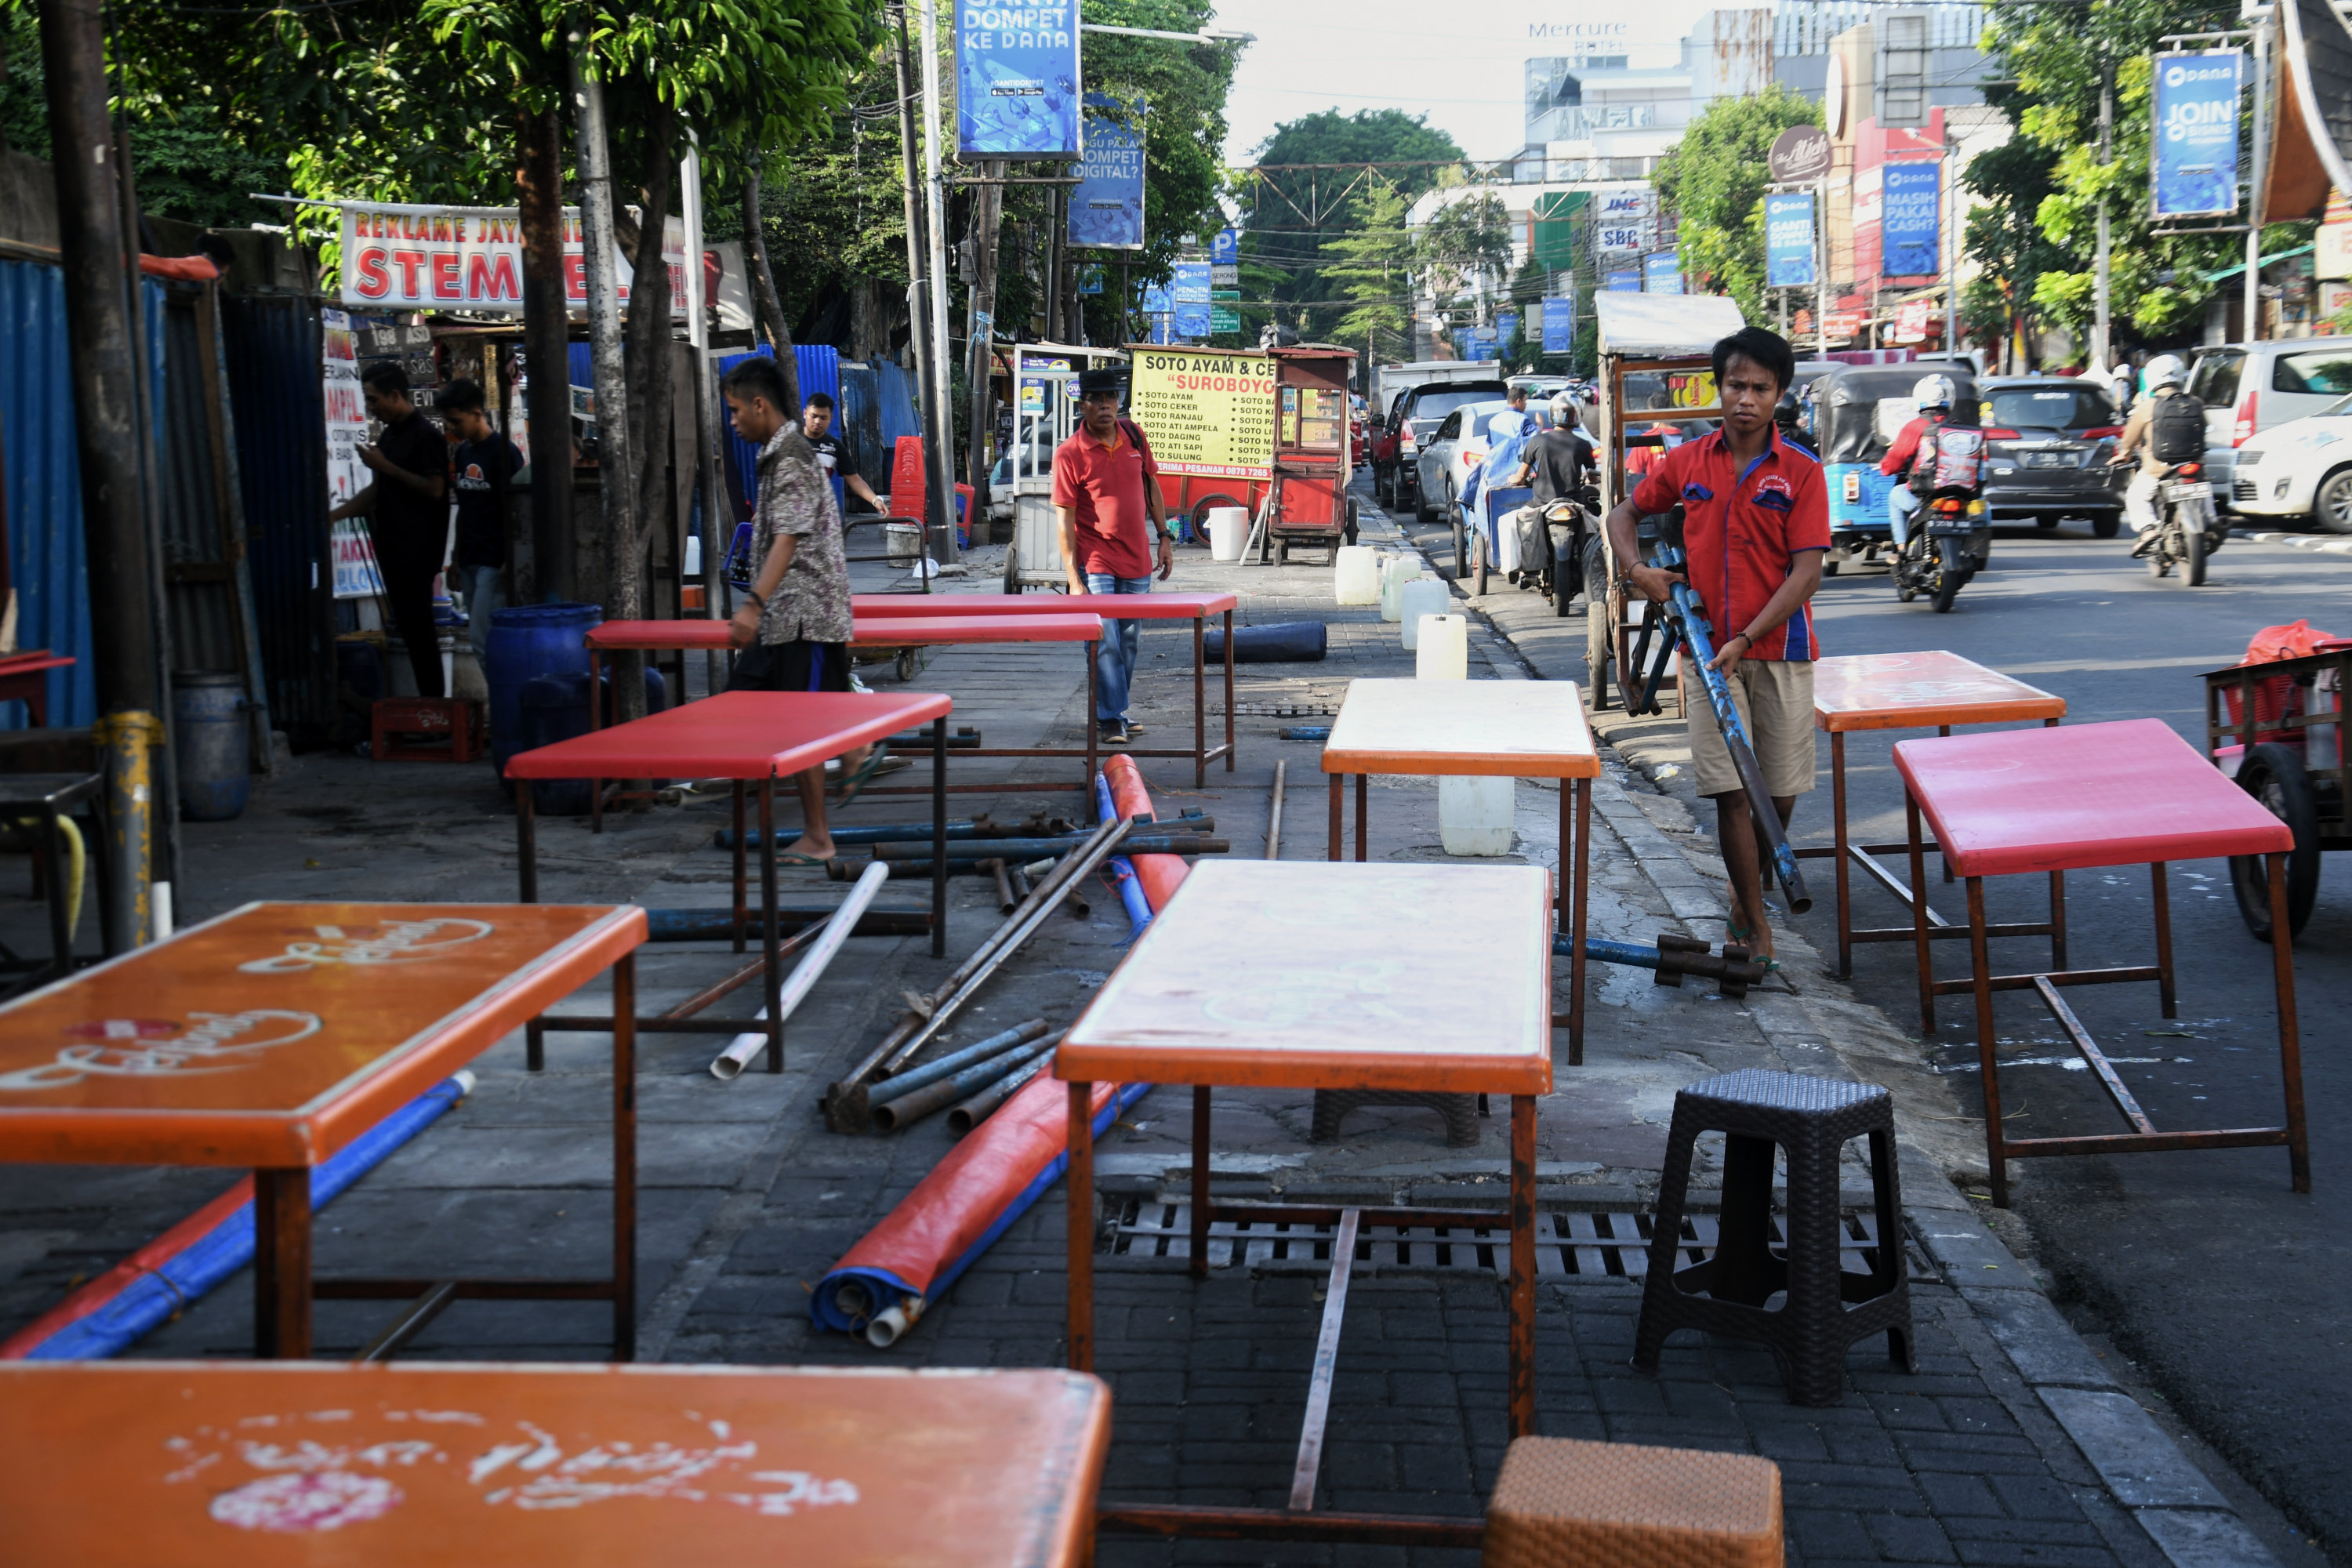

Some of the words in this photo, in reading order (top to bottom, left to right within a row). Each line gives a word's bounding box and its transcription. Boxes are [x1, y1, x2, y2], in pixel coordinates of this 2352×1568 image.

[964, 9, 1068, 29] DOMPET
[1529, 23, 1628, 38] Mercure
[964, 31, 993, 49] KE
[1002, 31, 1069, 49] DANA
[2163, 100, 2233, 126] JOIN
[1083, 150, 1139, 164] OMPET
[1073, 165, 1139, 179] DIGITAL?
[1886, 191, 1936, 205] MASIH
[1886, 205, 1936, 219] PAKAI
[356, 212, 466, 242] REKLAME
[478, 218, 521, 243] JAY
[1769, 220, 1810, 233] GANTI
[1886, 219, 1936, 232] CASH?
[1214, 233, 1232, 260] P
[1145, 356, 1187, 371] SOTO
[1192, 359, 1234, 374] AYAM
[1240, 361, 1250, 375] &
[1167, 452, 1202, 461] SULUNG
[1158, 462, 1184, 472] ERIMA
[1185, 463, 1225, 474] PESANAN
[1226, 466, 1246, 475] 0878
[1248, 468, 1268, 477] 7265
